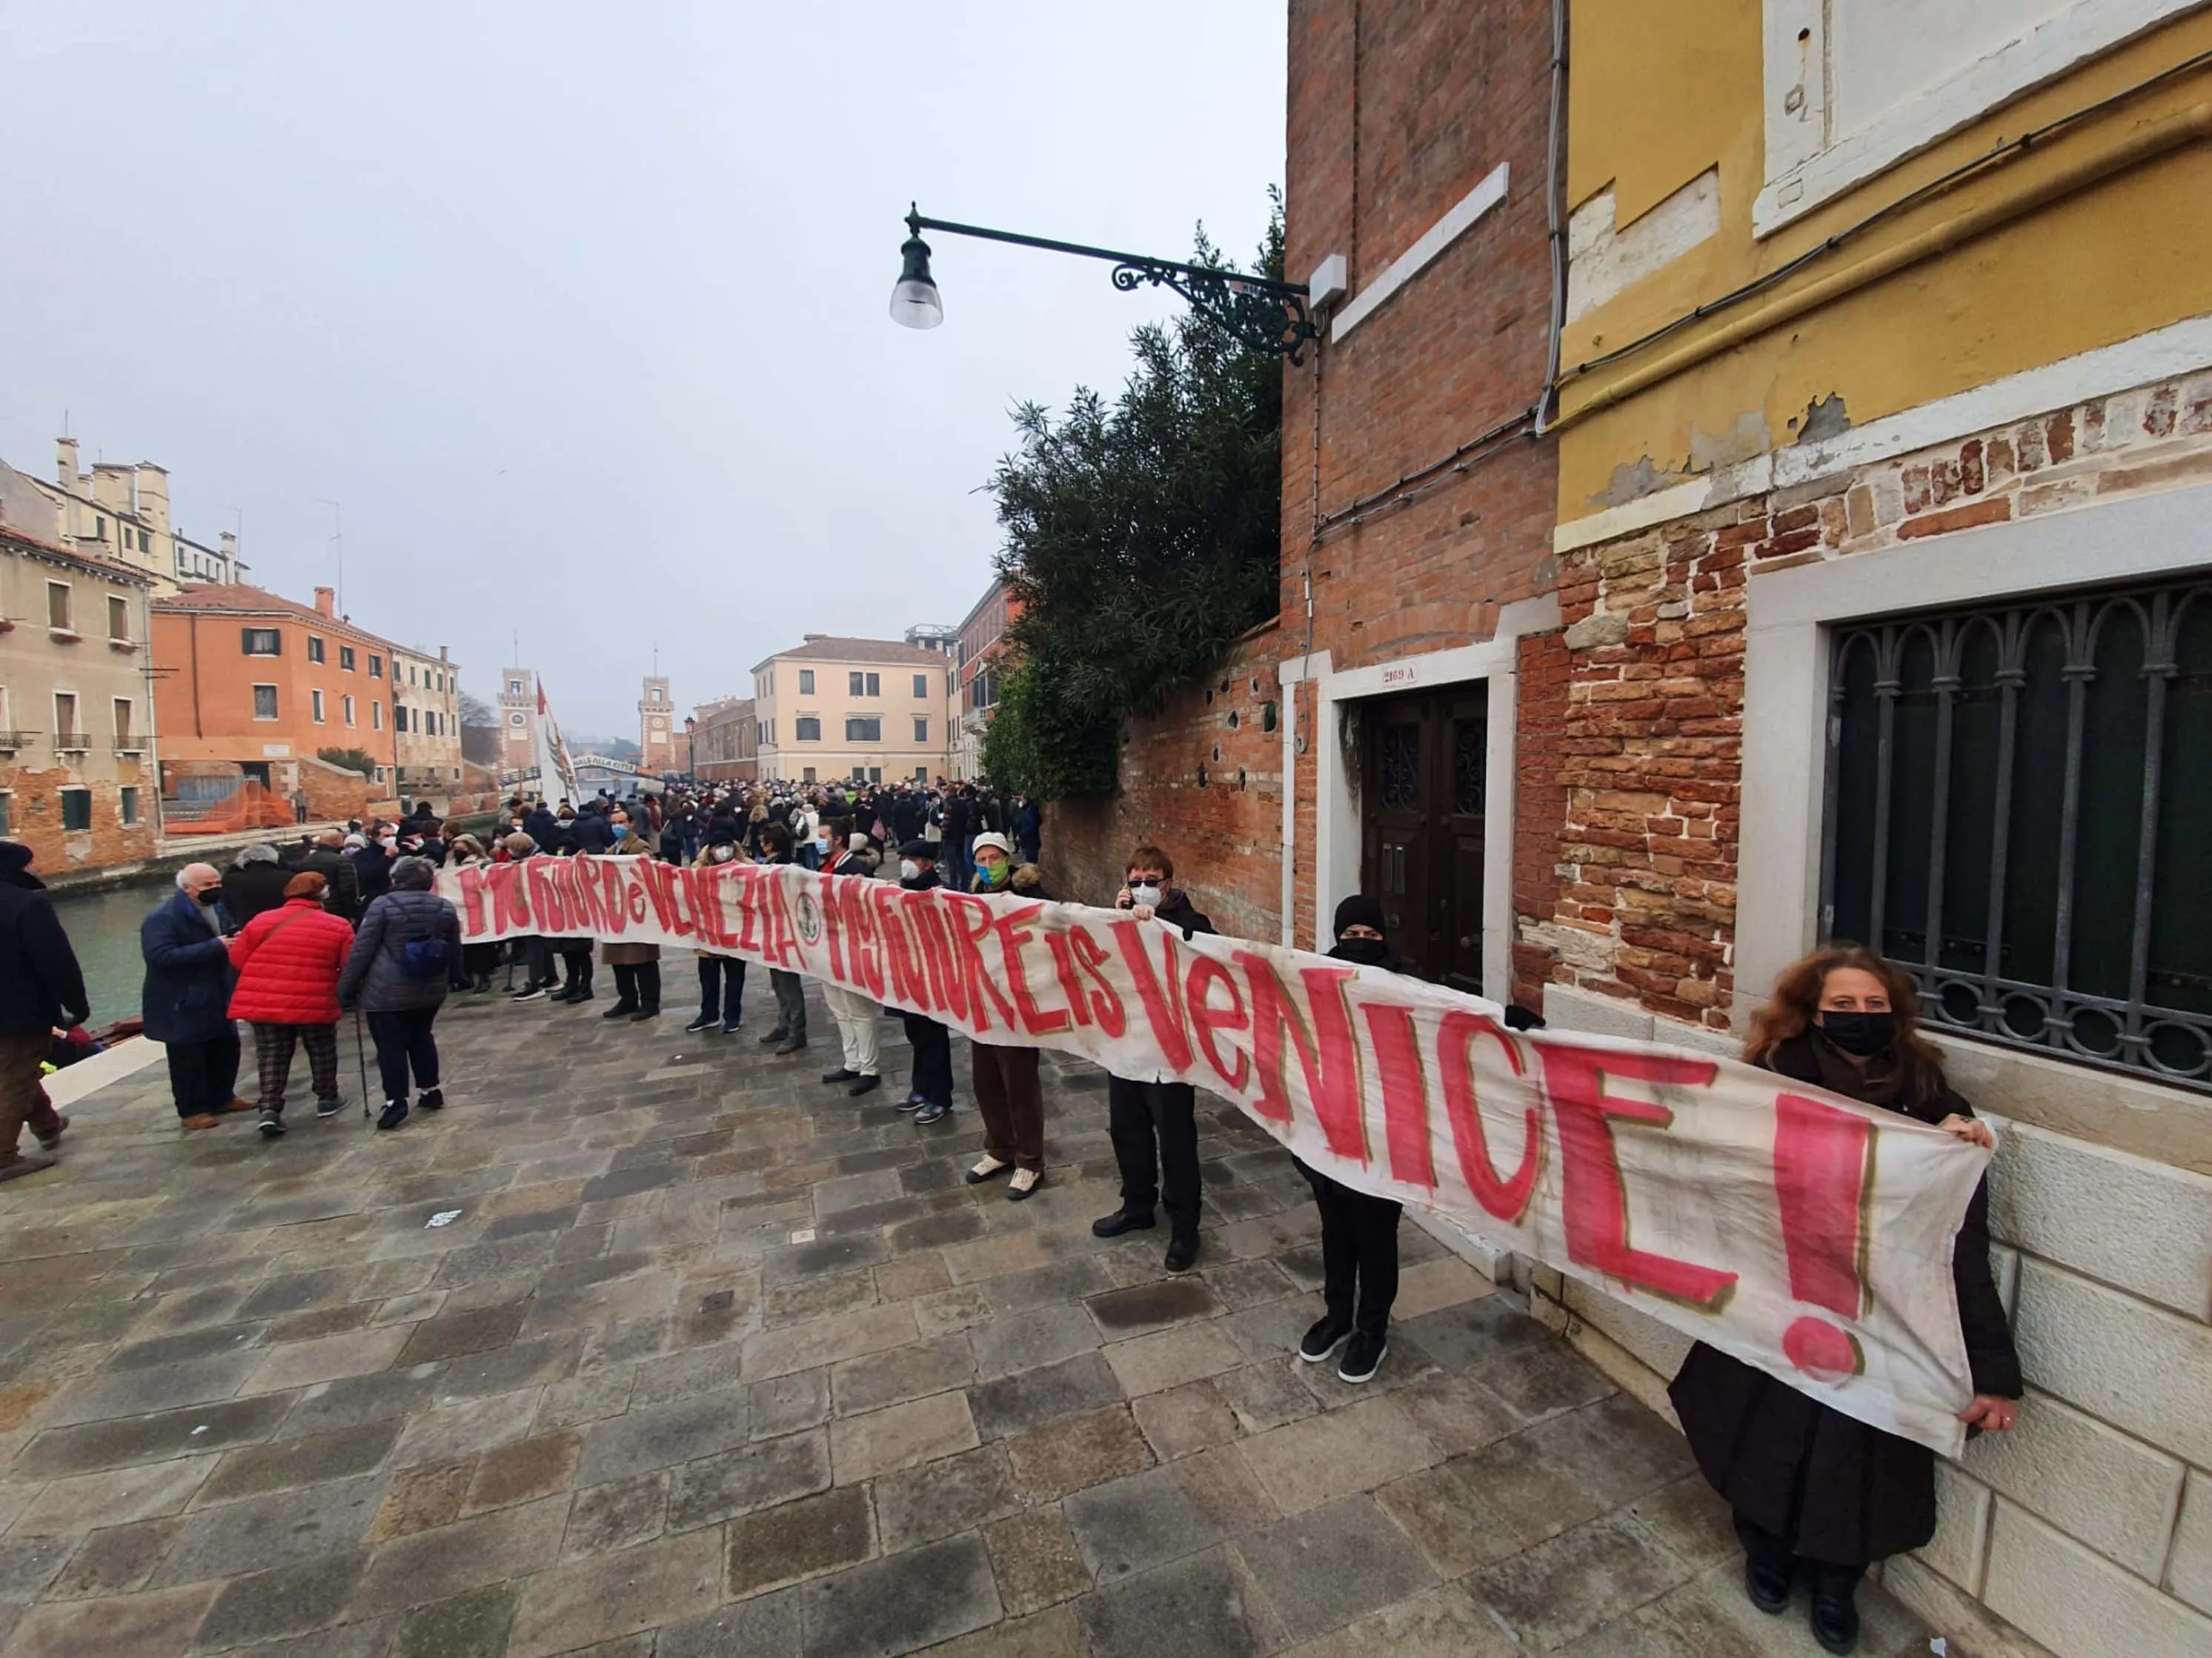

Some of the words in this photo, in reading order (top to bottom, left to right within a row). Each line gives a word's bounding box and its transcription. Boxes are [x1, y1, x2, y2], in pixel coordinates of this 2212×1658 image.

[1407, 667, 1414, 679] A
[528, 856, 627, 934] FUTURO
[638, 857, 807, 971] VENEZIA
[820, 875, 886, 1000] MY
[874, 885, 1072, 1036] FUTURE
[1044, 925, 1126, 1039] IS
